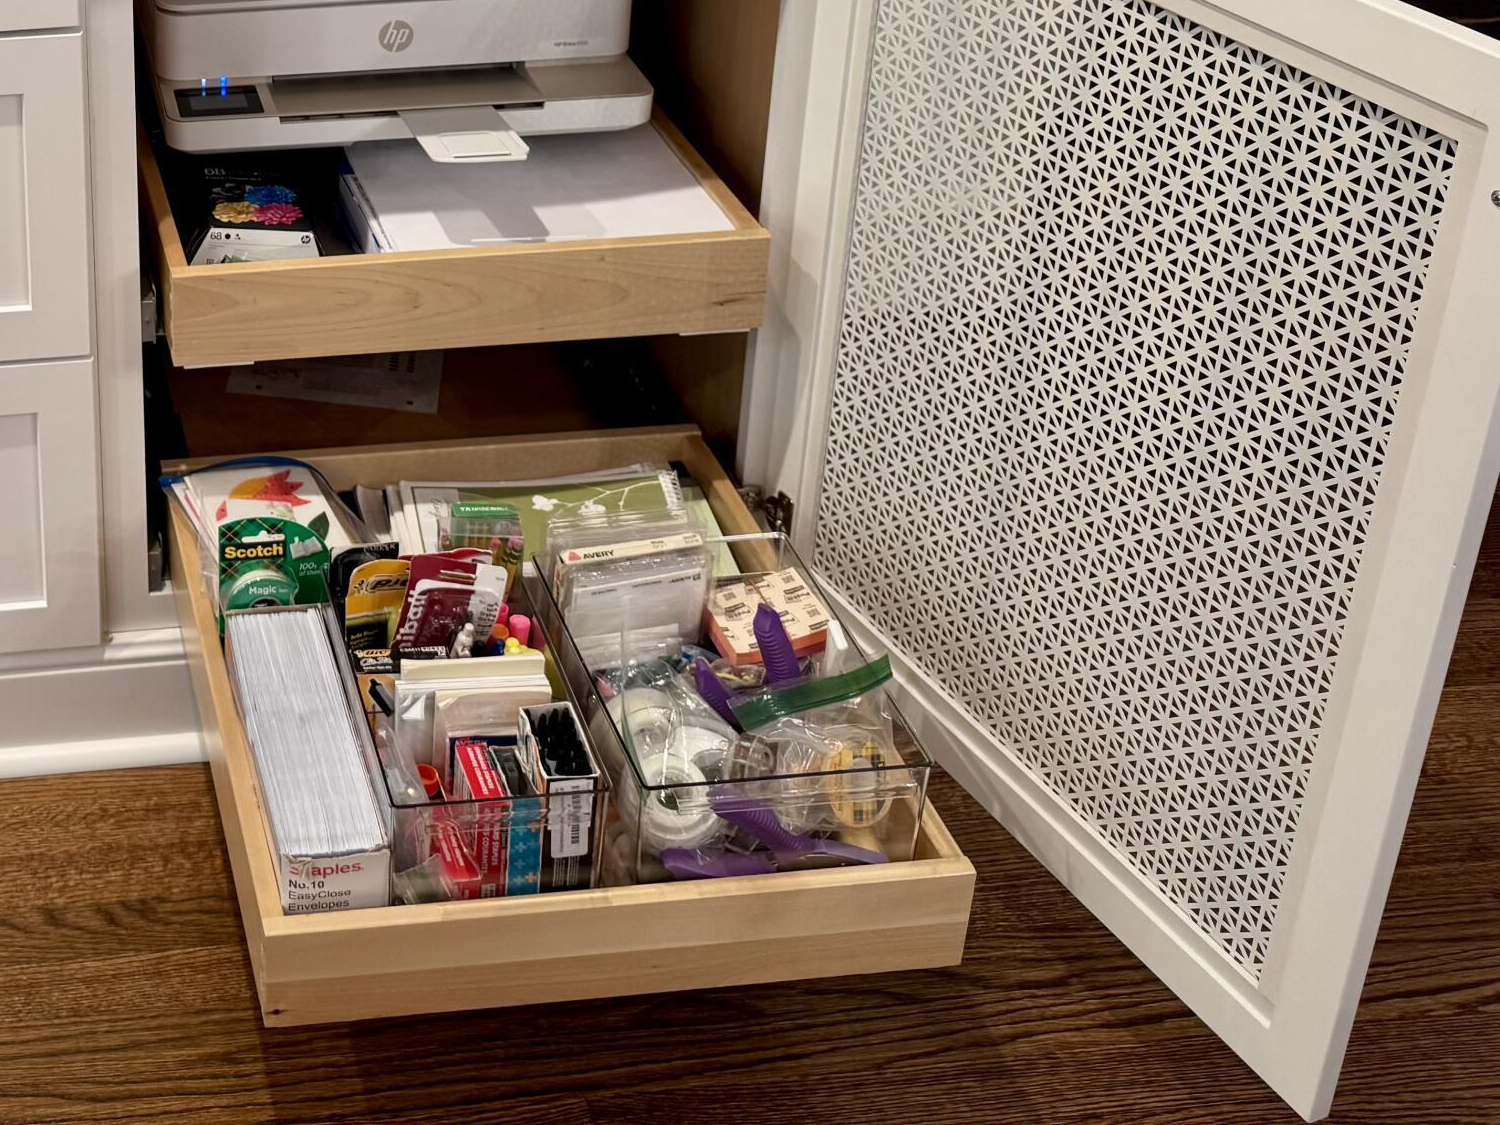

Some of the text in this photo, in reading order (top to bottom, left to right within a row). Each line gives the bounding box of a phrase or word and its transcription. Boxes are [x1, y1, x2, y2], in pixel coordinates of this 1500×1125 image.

[382, 20, 411, 53] hp
[210, 232, 222, 240] 68
[224, 544, 284, 559] Scotch
[583, 549, 614, 560] AVERY
[249, 585, 277, 595] Magic
[289, 862, 362, 878] Saples
[288, 889, 351, 900] EasyClose
[288, 900, 349, 912] Envelopes
